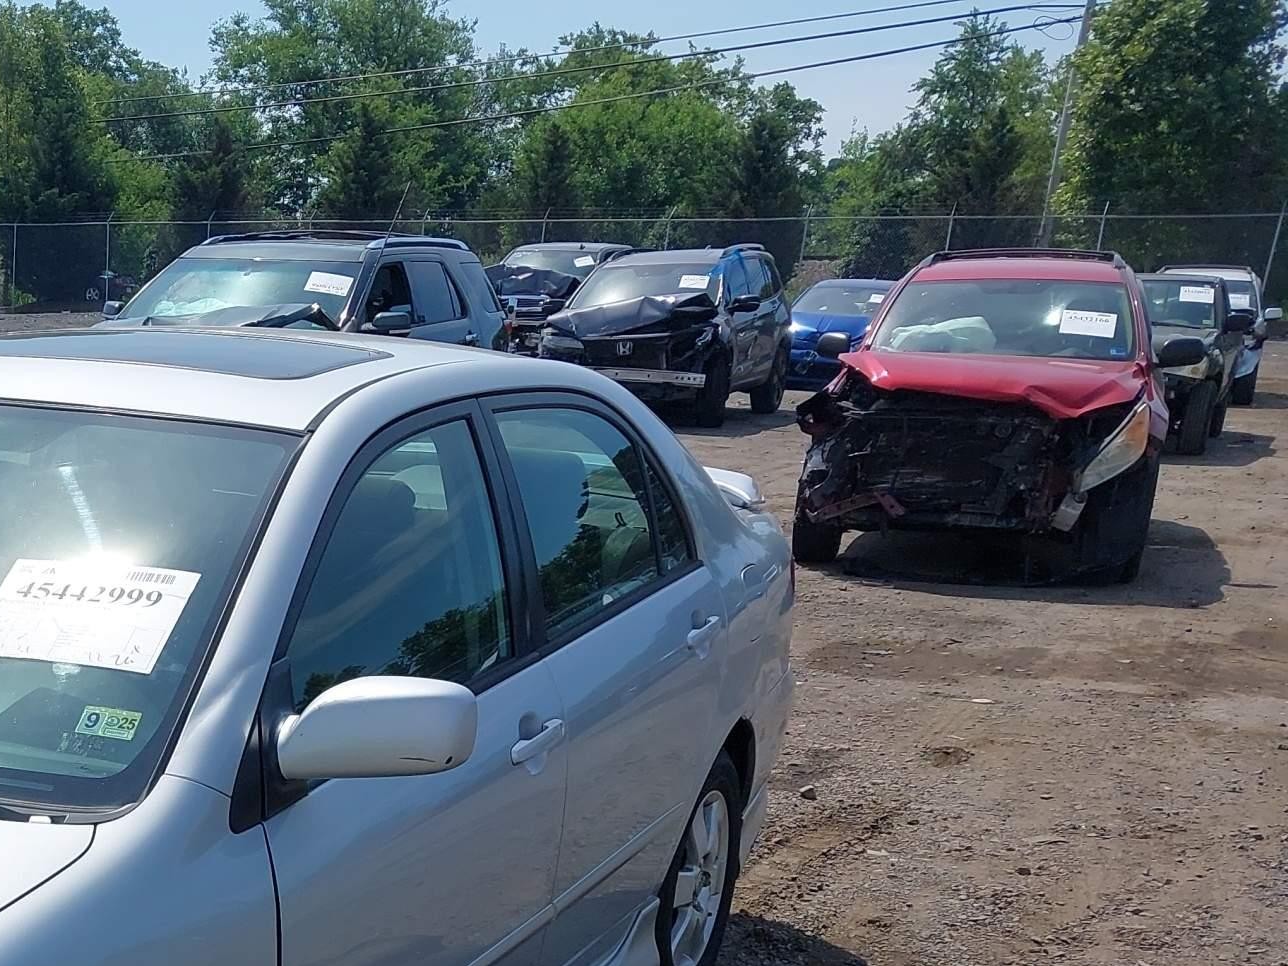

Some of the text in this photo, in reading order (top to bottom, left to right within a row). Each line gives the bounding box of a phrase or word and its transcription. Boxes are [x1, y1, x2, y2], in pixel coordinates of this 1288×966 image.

[16, 582, 163, 607] 45442999
[84, 712, 138, 731] 9 25
